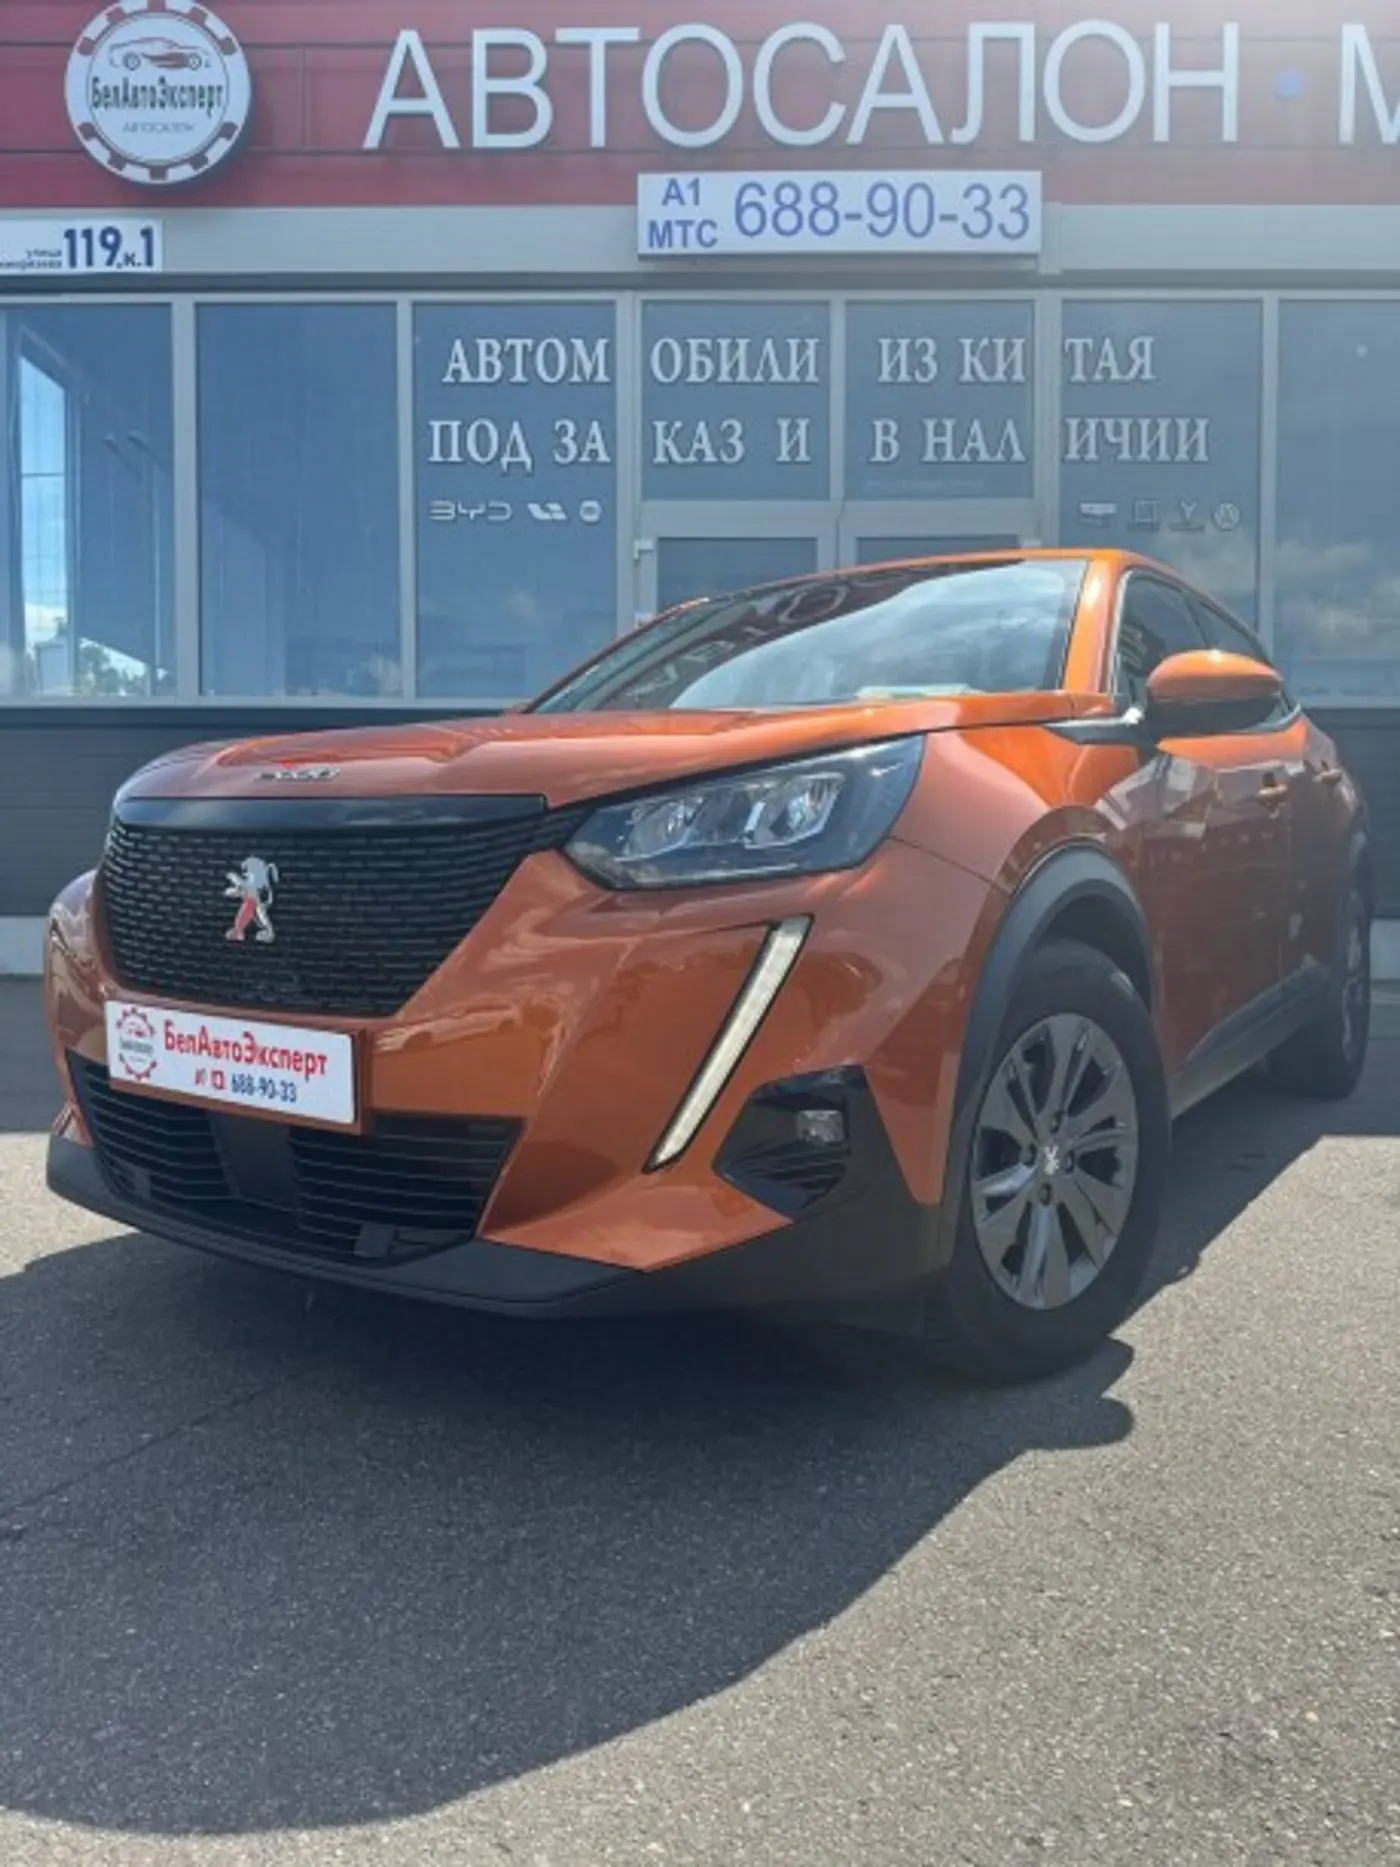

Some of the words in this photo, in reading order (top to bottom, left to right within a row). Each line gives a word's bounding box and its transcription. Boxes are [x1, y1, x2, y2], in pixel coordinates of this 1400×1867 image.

[91, 76, 224, 119] БелАвтоЭксперт
[363, 19, 1239, 151] АВТОСАЛОН
[647, 219, 719, 250] МТС
[734, 181, 1031, 240] 688-90-33
[878, 336, 938, 383] ИЗ
[427, 418, 534, 474] ПОД
[775, 417, 811, 463] И
[869, 419, 899, 463] В
[163, 1019, 328, 1083] БелАвтоЭксперт
[231, 1072, 297, 1103] 688-90-33
